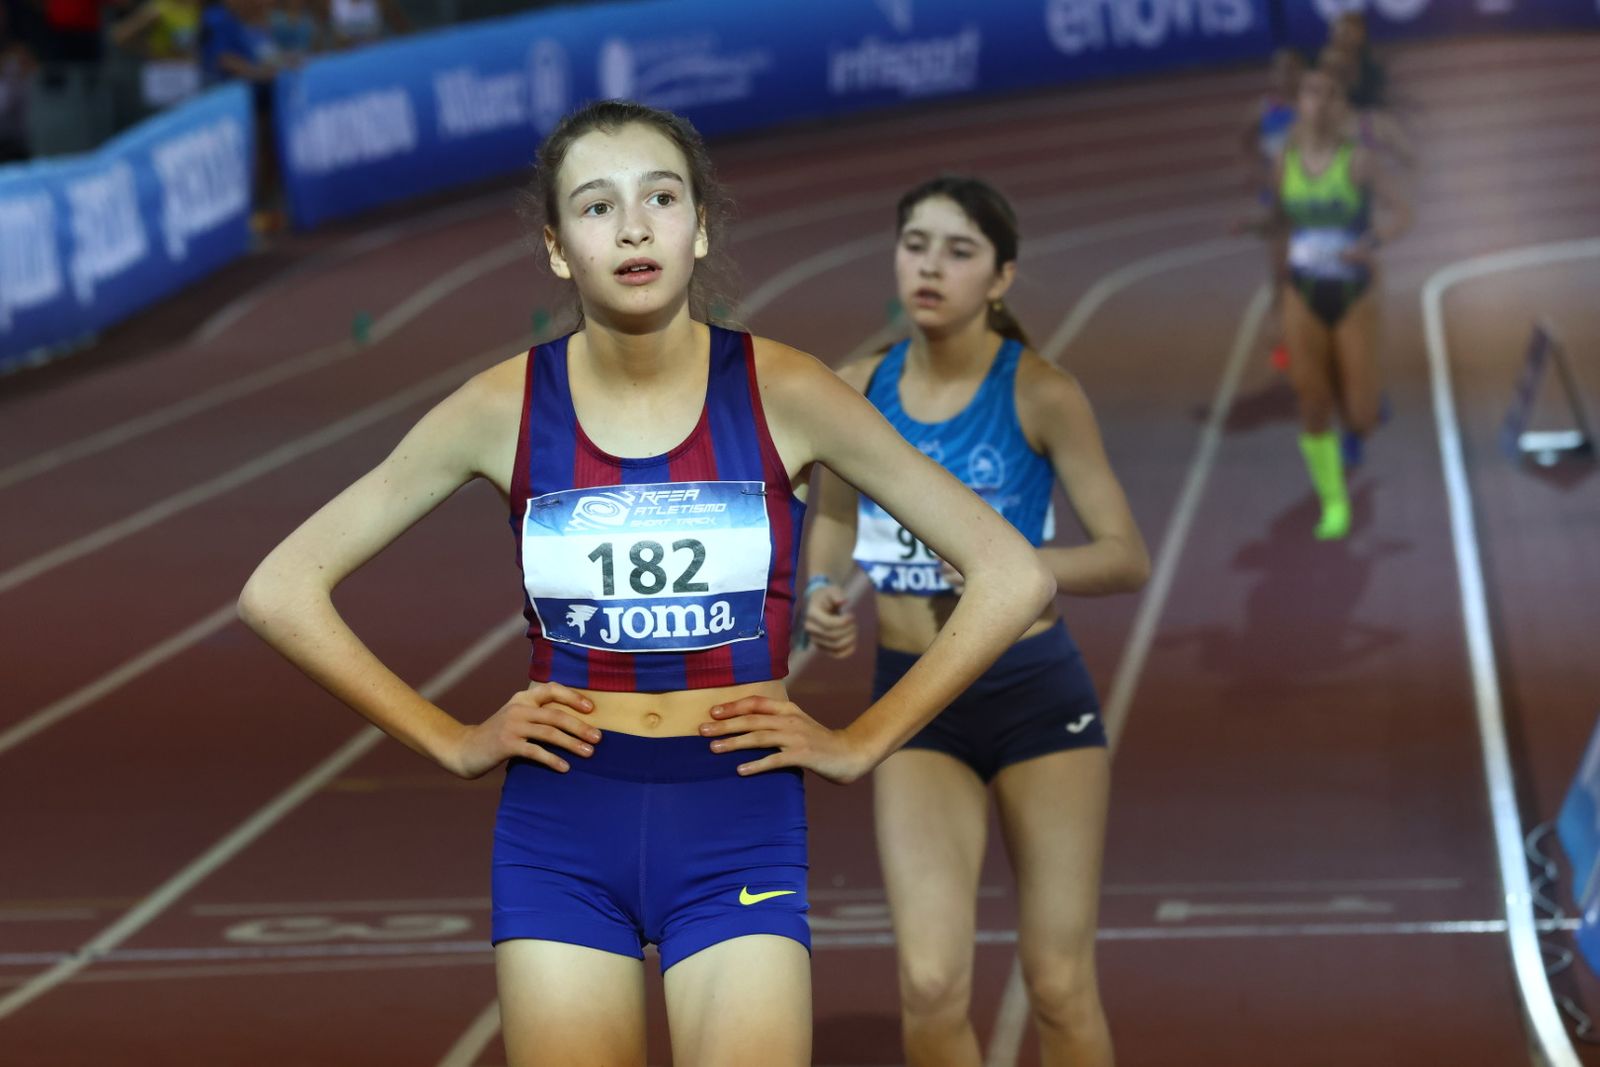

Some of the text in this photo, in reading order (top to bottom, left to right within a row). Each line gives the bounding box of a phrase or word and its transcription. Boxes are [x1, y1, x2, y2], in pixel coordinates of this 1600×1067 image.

[639, 489, 700, 505] RFEA
[633, 503, 727, 515] ATLETISMO
[588, 538, 709, 596] 182
